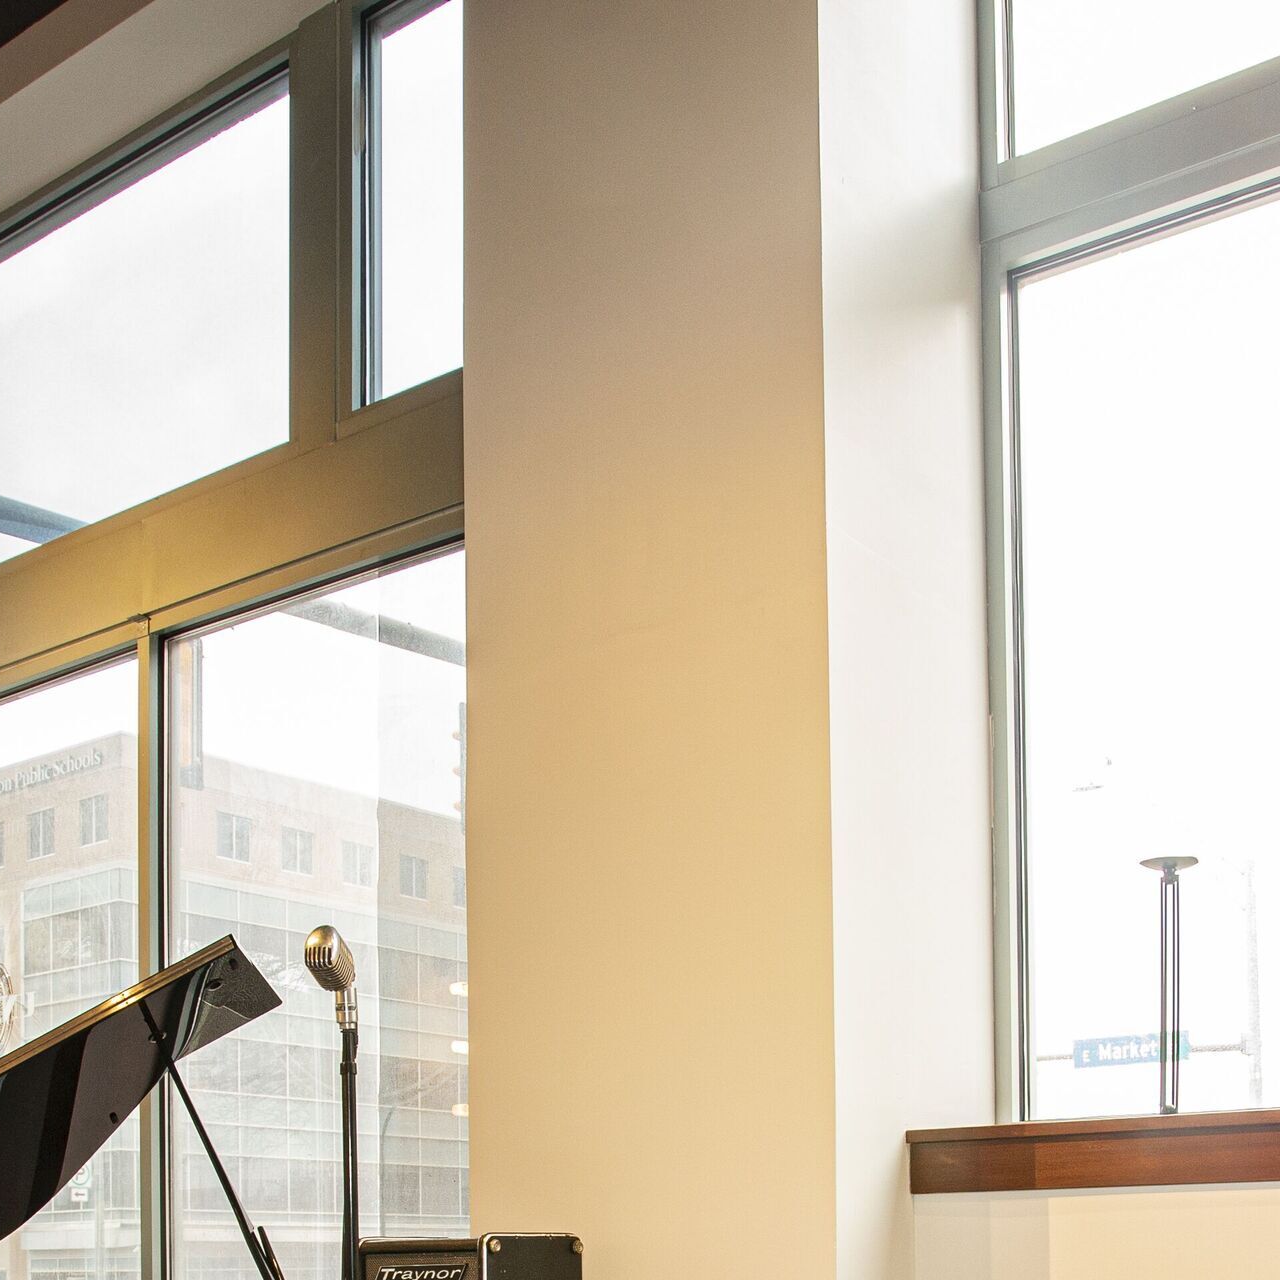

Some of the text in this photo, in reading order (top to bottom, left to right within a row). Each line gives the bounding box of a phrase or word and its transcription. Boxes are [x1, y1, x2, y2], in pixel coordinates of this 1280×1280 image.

[15, 765, 53, 788] Public
[53, 748, 103, 777] Schools
[1098, 1040, 1158, 1060] Market
